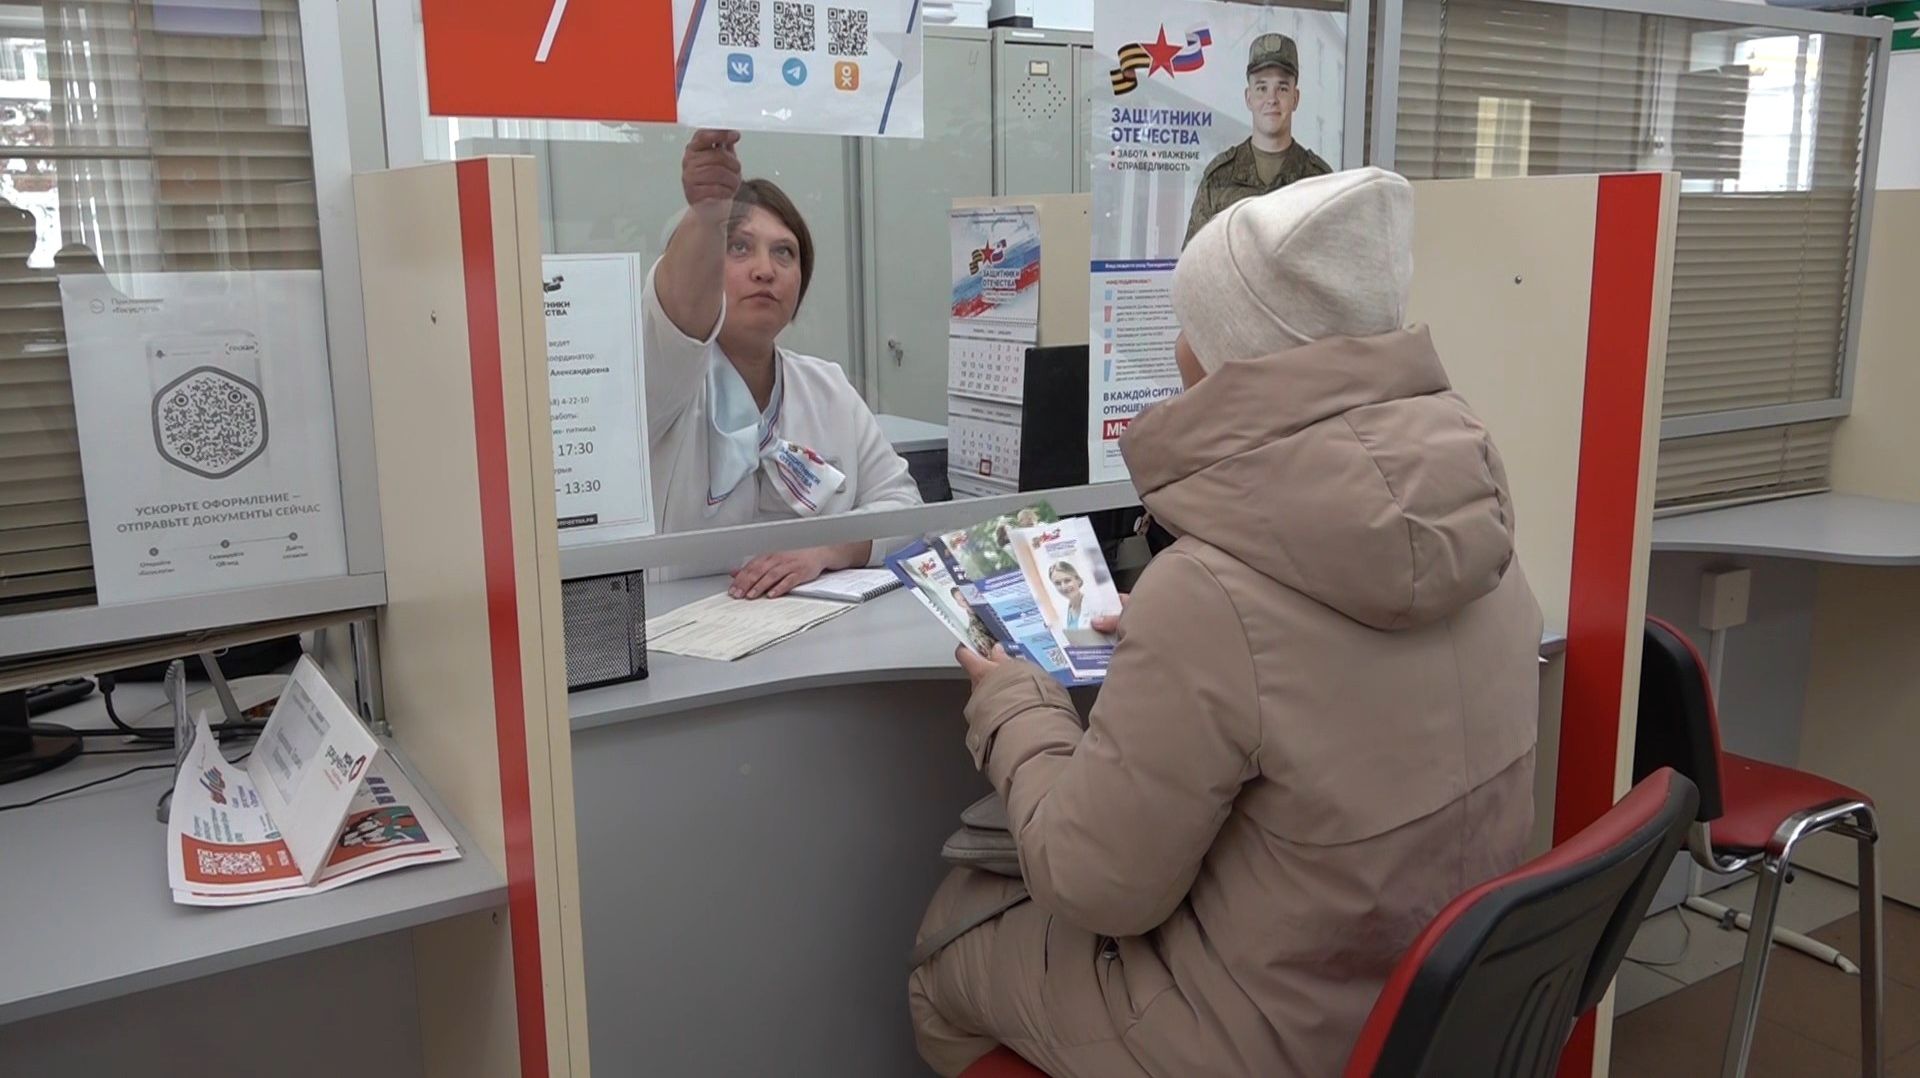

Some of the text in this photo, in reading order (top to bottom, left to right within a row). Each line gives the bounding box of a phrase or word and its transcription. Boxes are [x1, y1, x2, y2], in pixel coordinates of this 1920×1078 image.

[1111, 107, 1212, 127] ЗАЩИТНИКИ
[1111, 127, 1200, 145] ОТЕЧЕСТВА
[1117, 149, 1200, 160] ЗАБОТА УВАЖЕНИЕ
[1117, 161, 1190, 172] СПРАВЕДЛИВОСТЬ
[544, 308, 567, 317] СТВА
[548, 353, 594, 362] оординатор
[550, 367, 610, 377] Александровна
[1103, 393, 1109, 401] В
[1111, 387, 1151, 401] КАЖДОЙ
[558, 441, 594, 457] 17:30
[565, 480, 601, 494] 13:30
[135, 501, 199, 516] УСКОРЬТЕ
[201, 492, 290, 510] ОФОРМЛЕНИЕ
[116, 503, 321, 534] ОТПРАВЬТЕ ДОКУМЕНТЫ СЕЙЧАС
